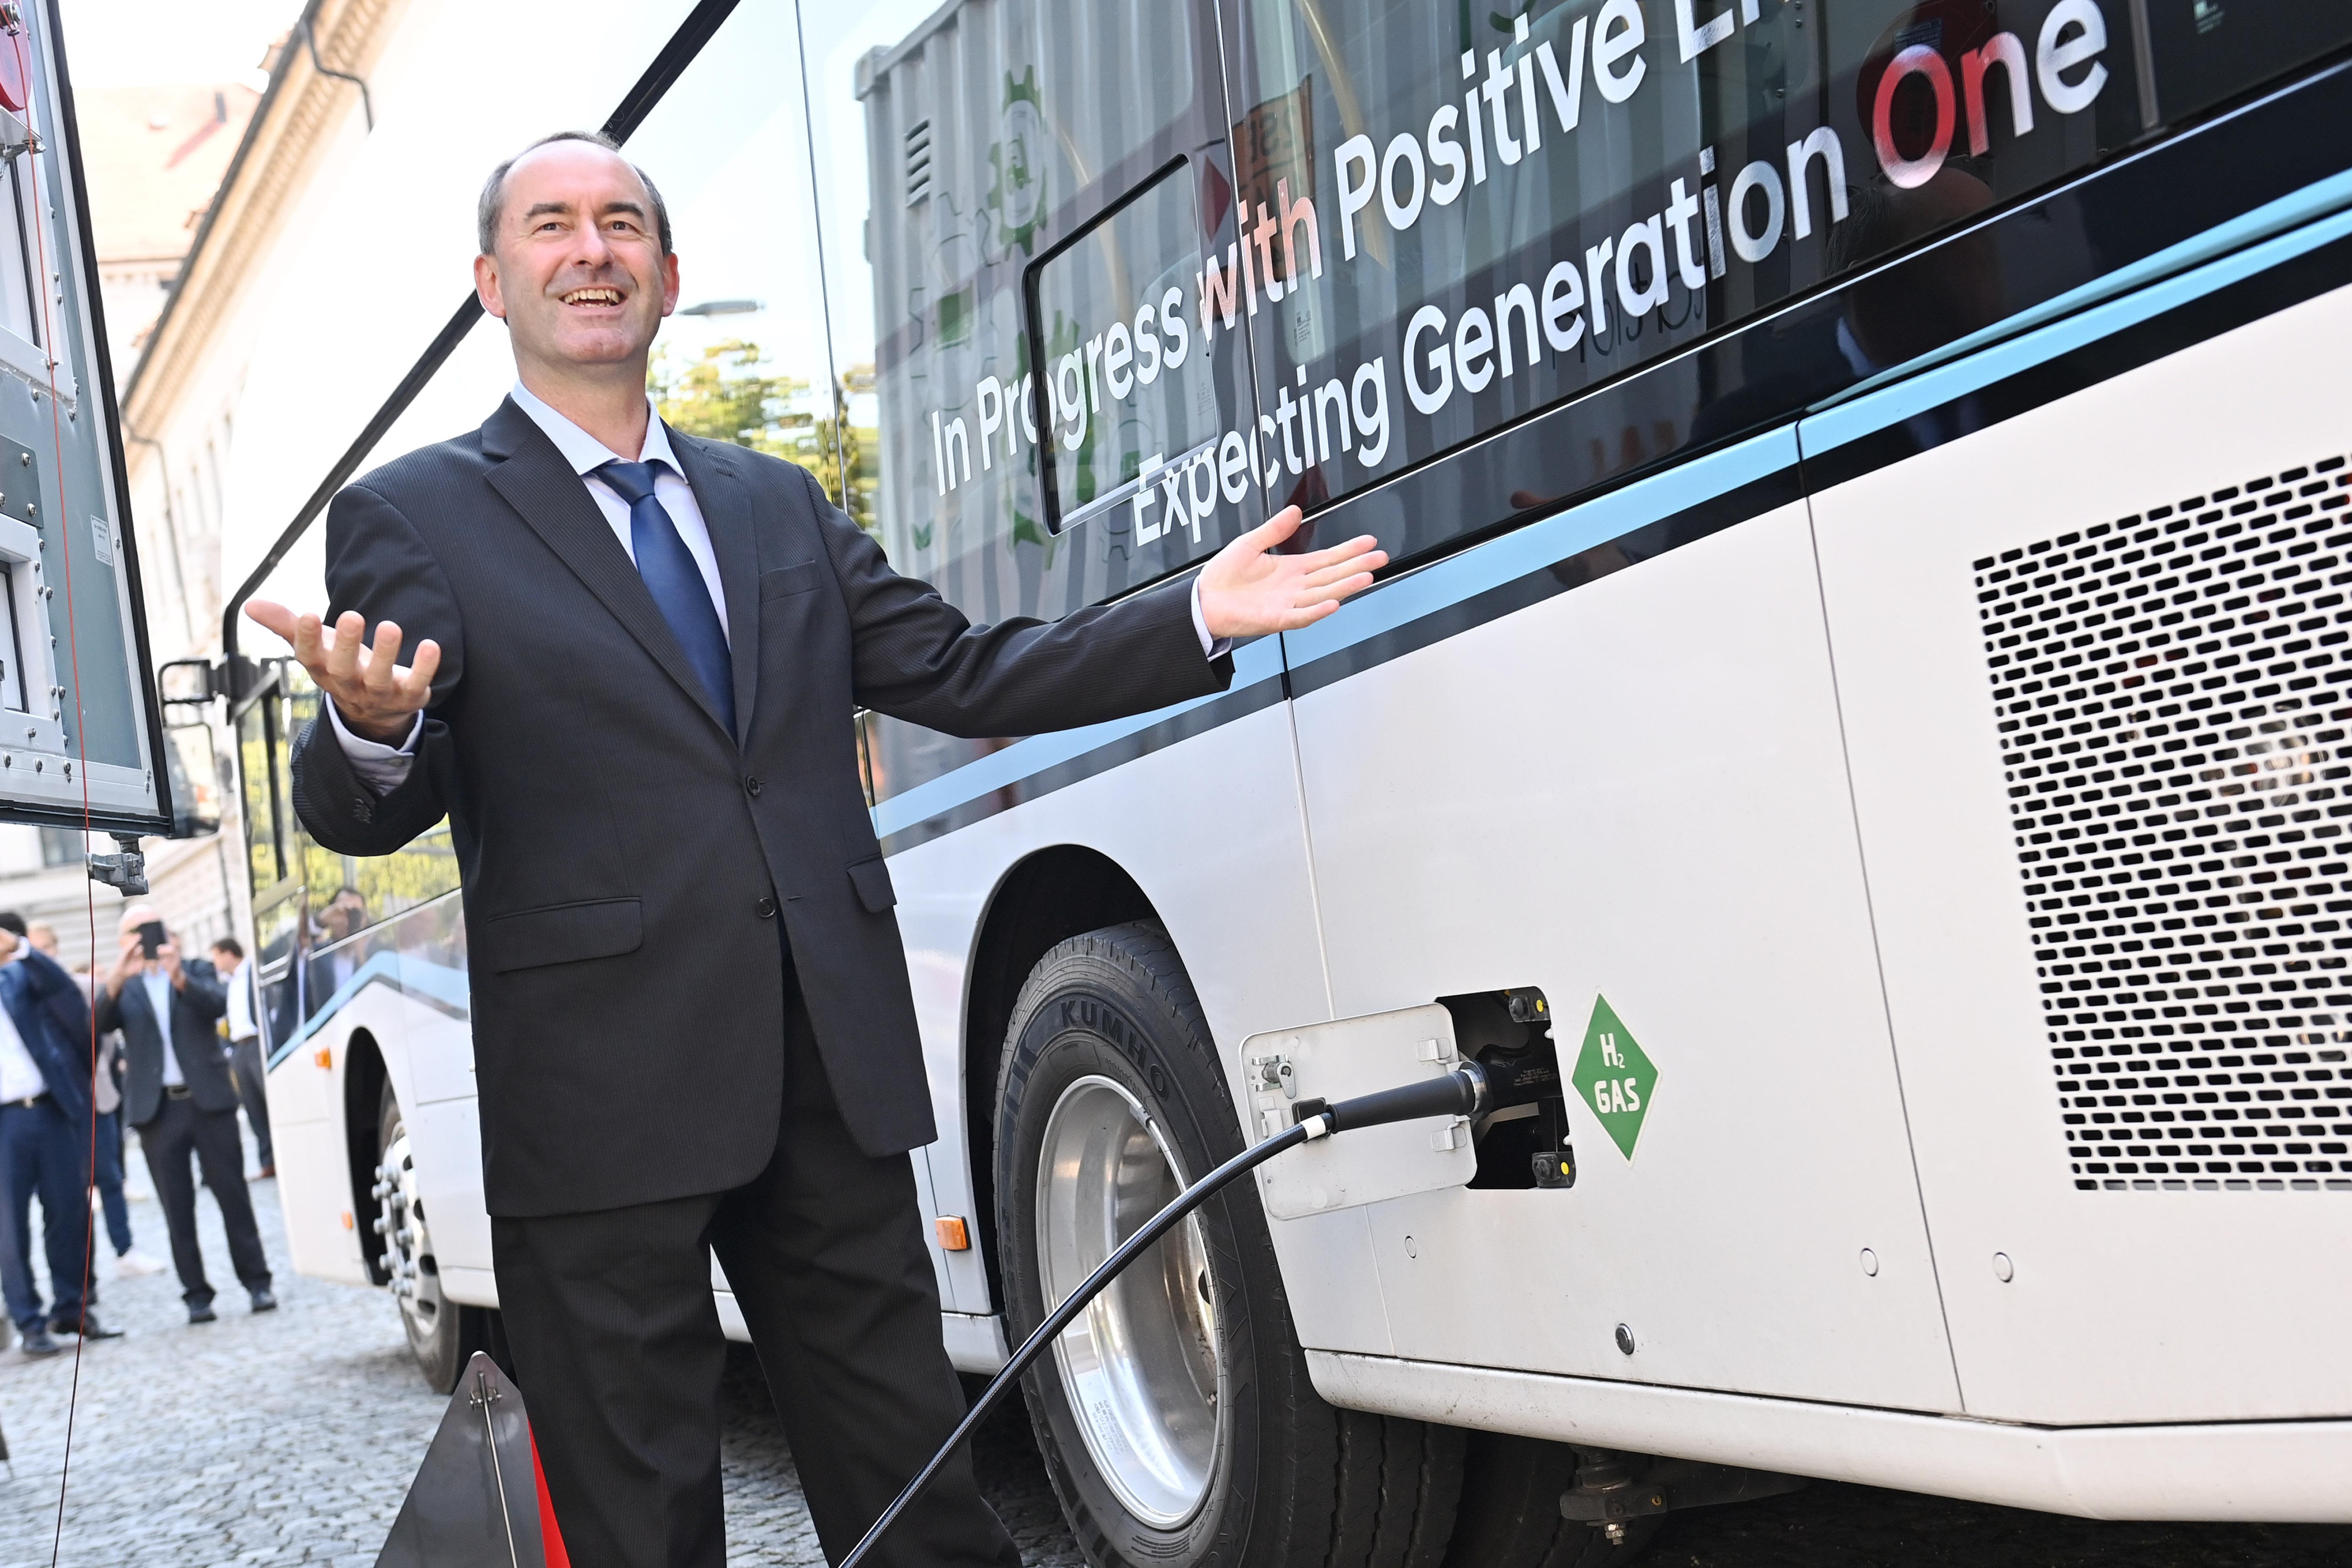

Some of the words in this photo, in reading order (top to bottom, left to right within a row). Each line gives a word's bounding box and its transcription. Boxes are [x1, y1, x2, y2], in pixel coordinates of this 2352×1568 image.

[932, 409, 971, 497] In
[976, 286, 1189, 471] Progress
[1196, 177, 1323, 341] with
[1334, 0, 1647, 261] Positive
[1133, 357, 1390, 547] Expecting
[1403, 125, 1849, 415] Generation
[1873, 0, 2108, 188] One
[1061, 999, 1169, 1100] KUMHO
[1594, 1078, 1640, 1113] GAS
